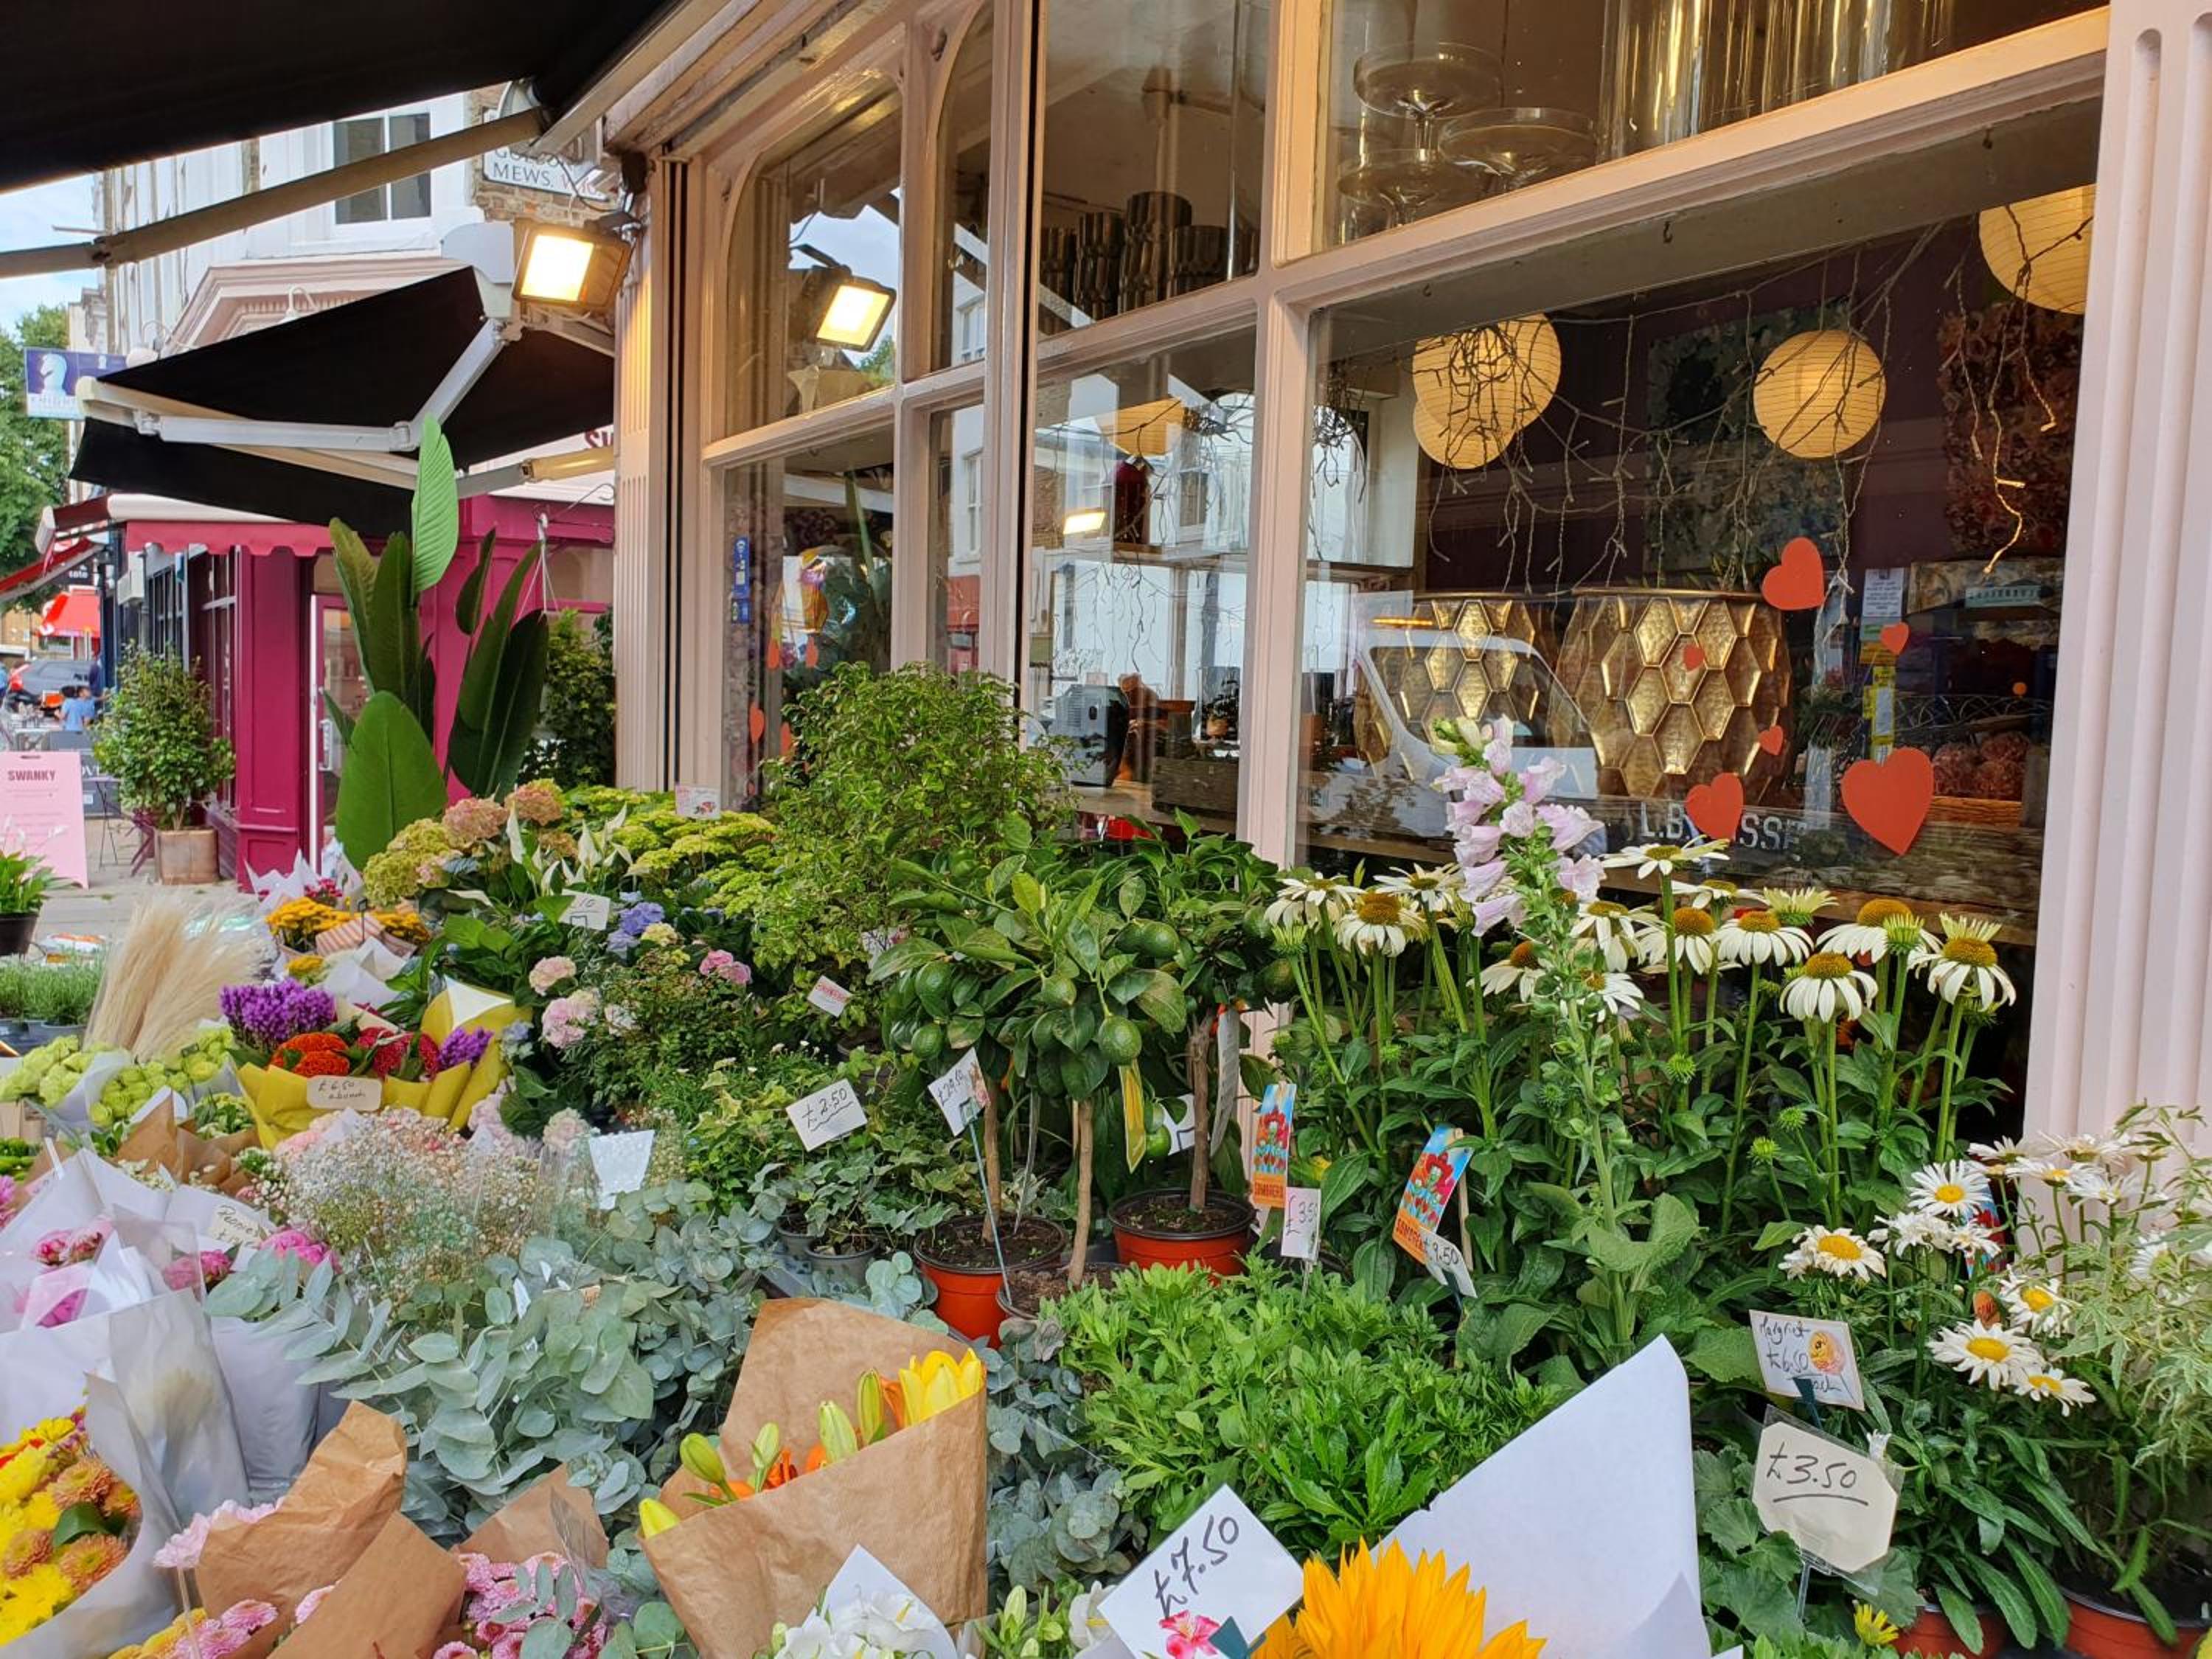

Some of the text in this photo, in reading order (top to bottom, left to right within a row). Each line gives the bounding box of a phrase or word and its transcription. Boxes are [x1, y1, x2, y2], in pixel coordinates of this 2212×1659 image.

[7, 770, 56, 781] SWANKY
[802, 1088, 847, 1128] £2.50
[1766, 1441, 1857, 1489] £3.50
[1154, 1514, 1239, 1619] £7.50
